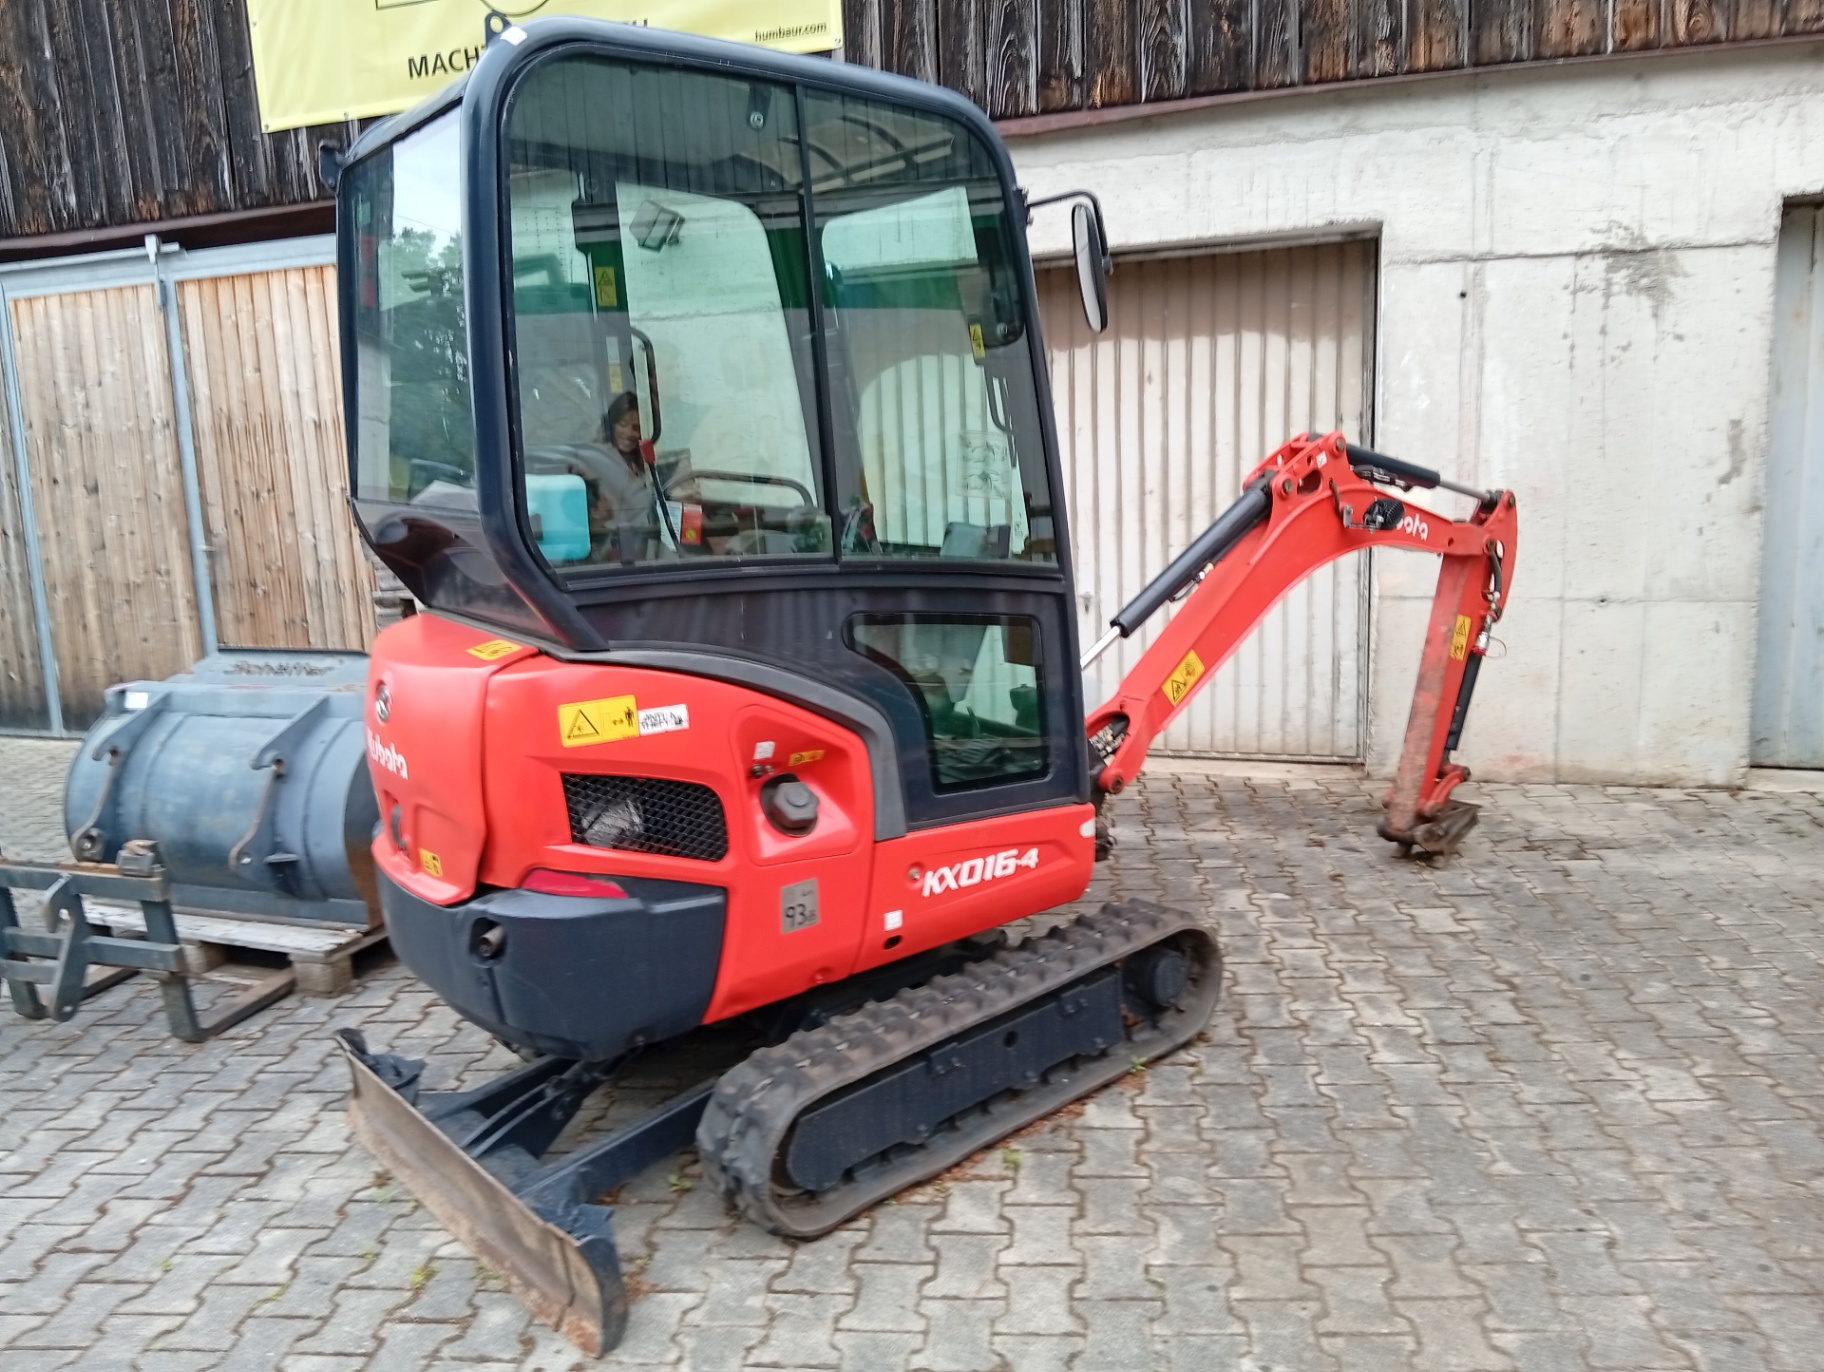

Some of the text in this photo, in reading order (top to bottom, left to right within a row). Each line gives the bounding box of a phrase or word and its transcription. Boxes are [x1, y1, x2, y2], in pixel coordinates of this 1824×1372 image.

[755, 23, 827, 42] humbaur.com
[407, 45, 486, 80] MACH
[922, 848, 1039, 897] KX016-4
[785, 903, 807, 928] 93
